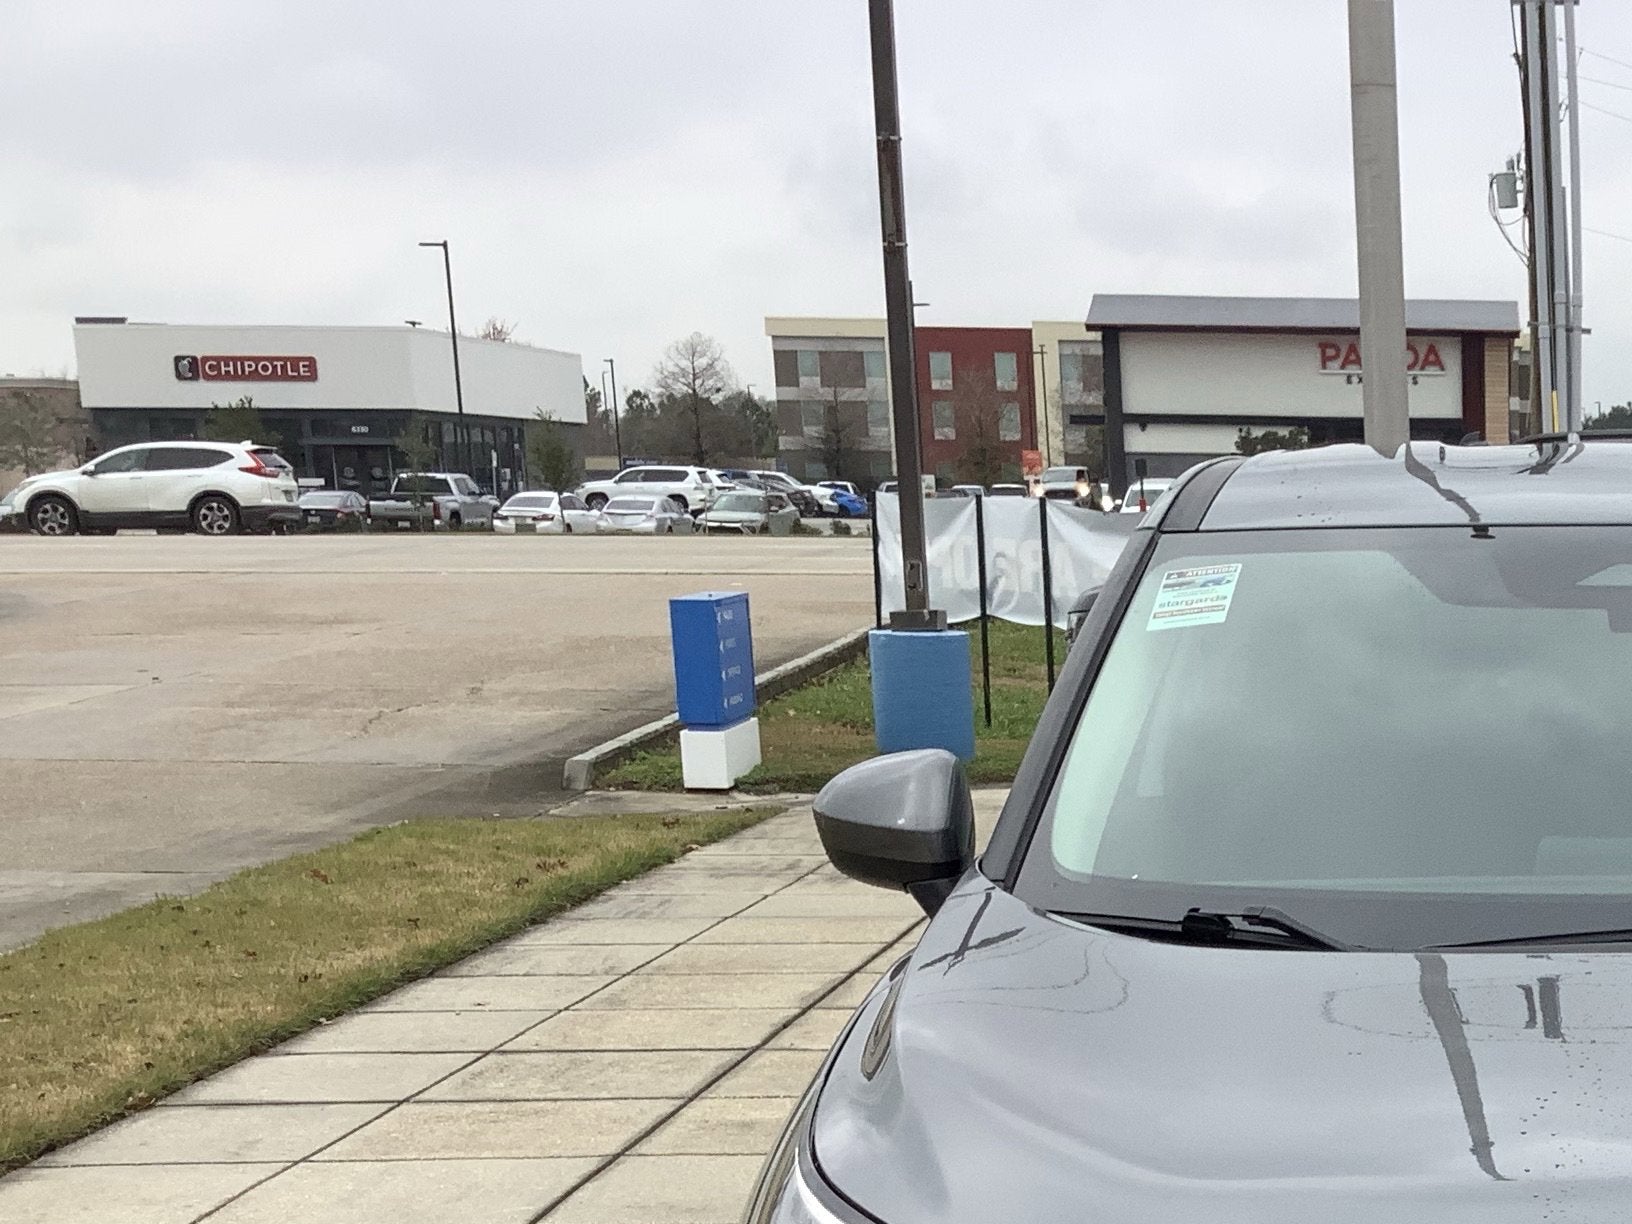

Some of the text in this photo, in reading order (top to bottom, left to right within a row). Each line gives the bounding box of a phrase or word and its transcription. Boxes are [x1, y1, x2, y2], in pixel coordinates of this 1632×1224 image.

[1318, 341, 1445, 371] PADA
[205, 361, 311, 376] CHIPOTLE
[1186, 566, 1236, 577] ATTENTION
